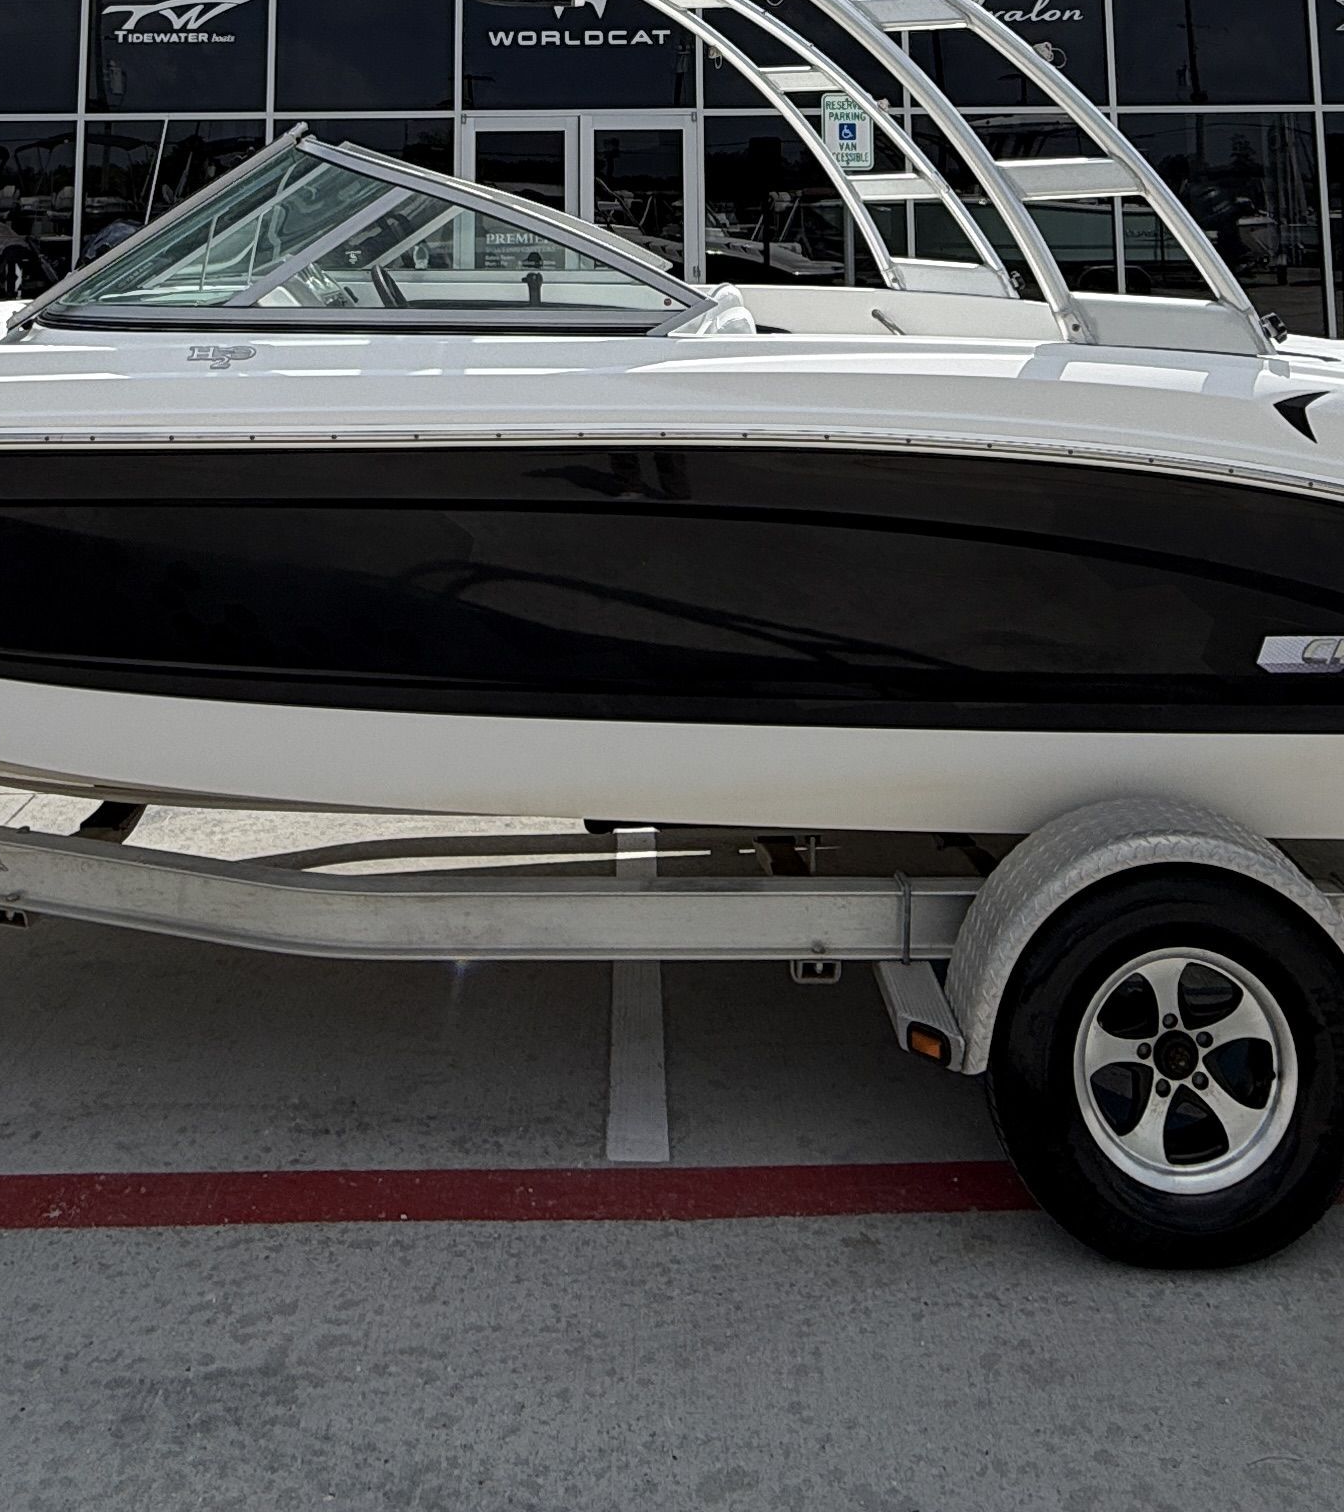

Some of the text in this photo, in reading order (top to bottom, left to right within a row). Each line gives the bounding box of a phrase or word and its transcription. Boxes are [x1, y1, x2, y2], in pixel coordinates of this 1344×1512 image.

[211, 34, 236, 43] boats
[488, 29, 671, 47] WORLDCAT
[825, 100, 864, 111] RESERV
[828, 111, 867, 122] PARKING
[839, 142, 858, 152] VAN
[831, 152, 870, 163] CESSIBLE
[485, 232, 549, 245] PREMIE
